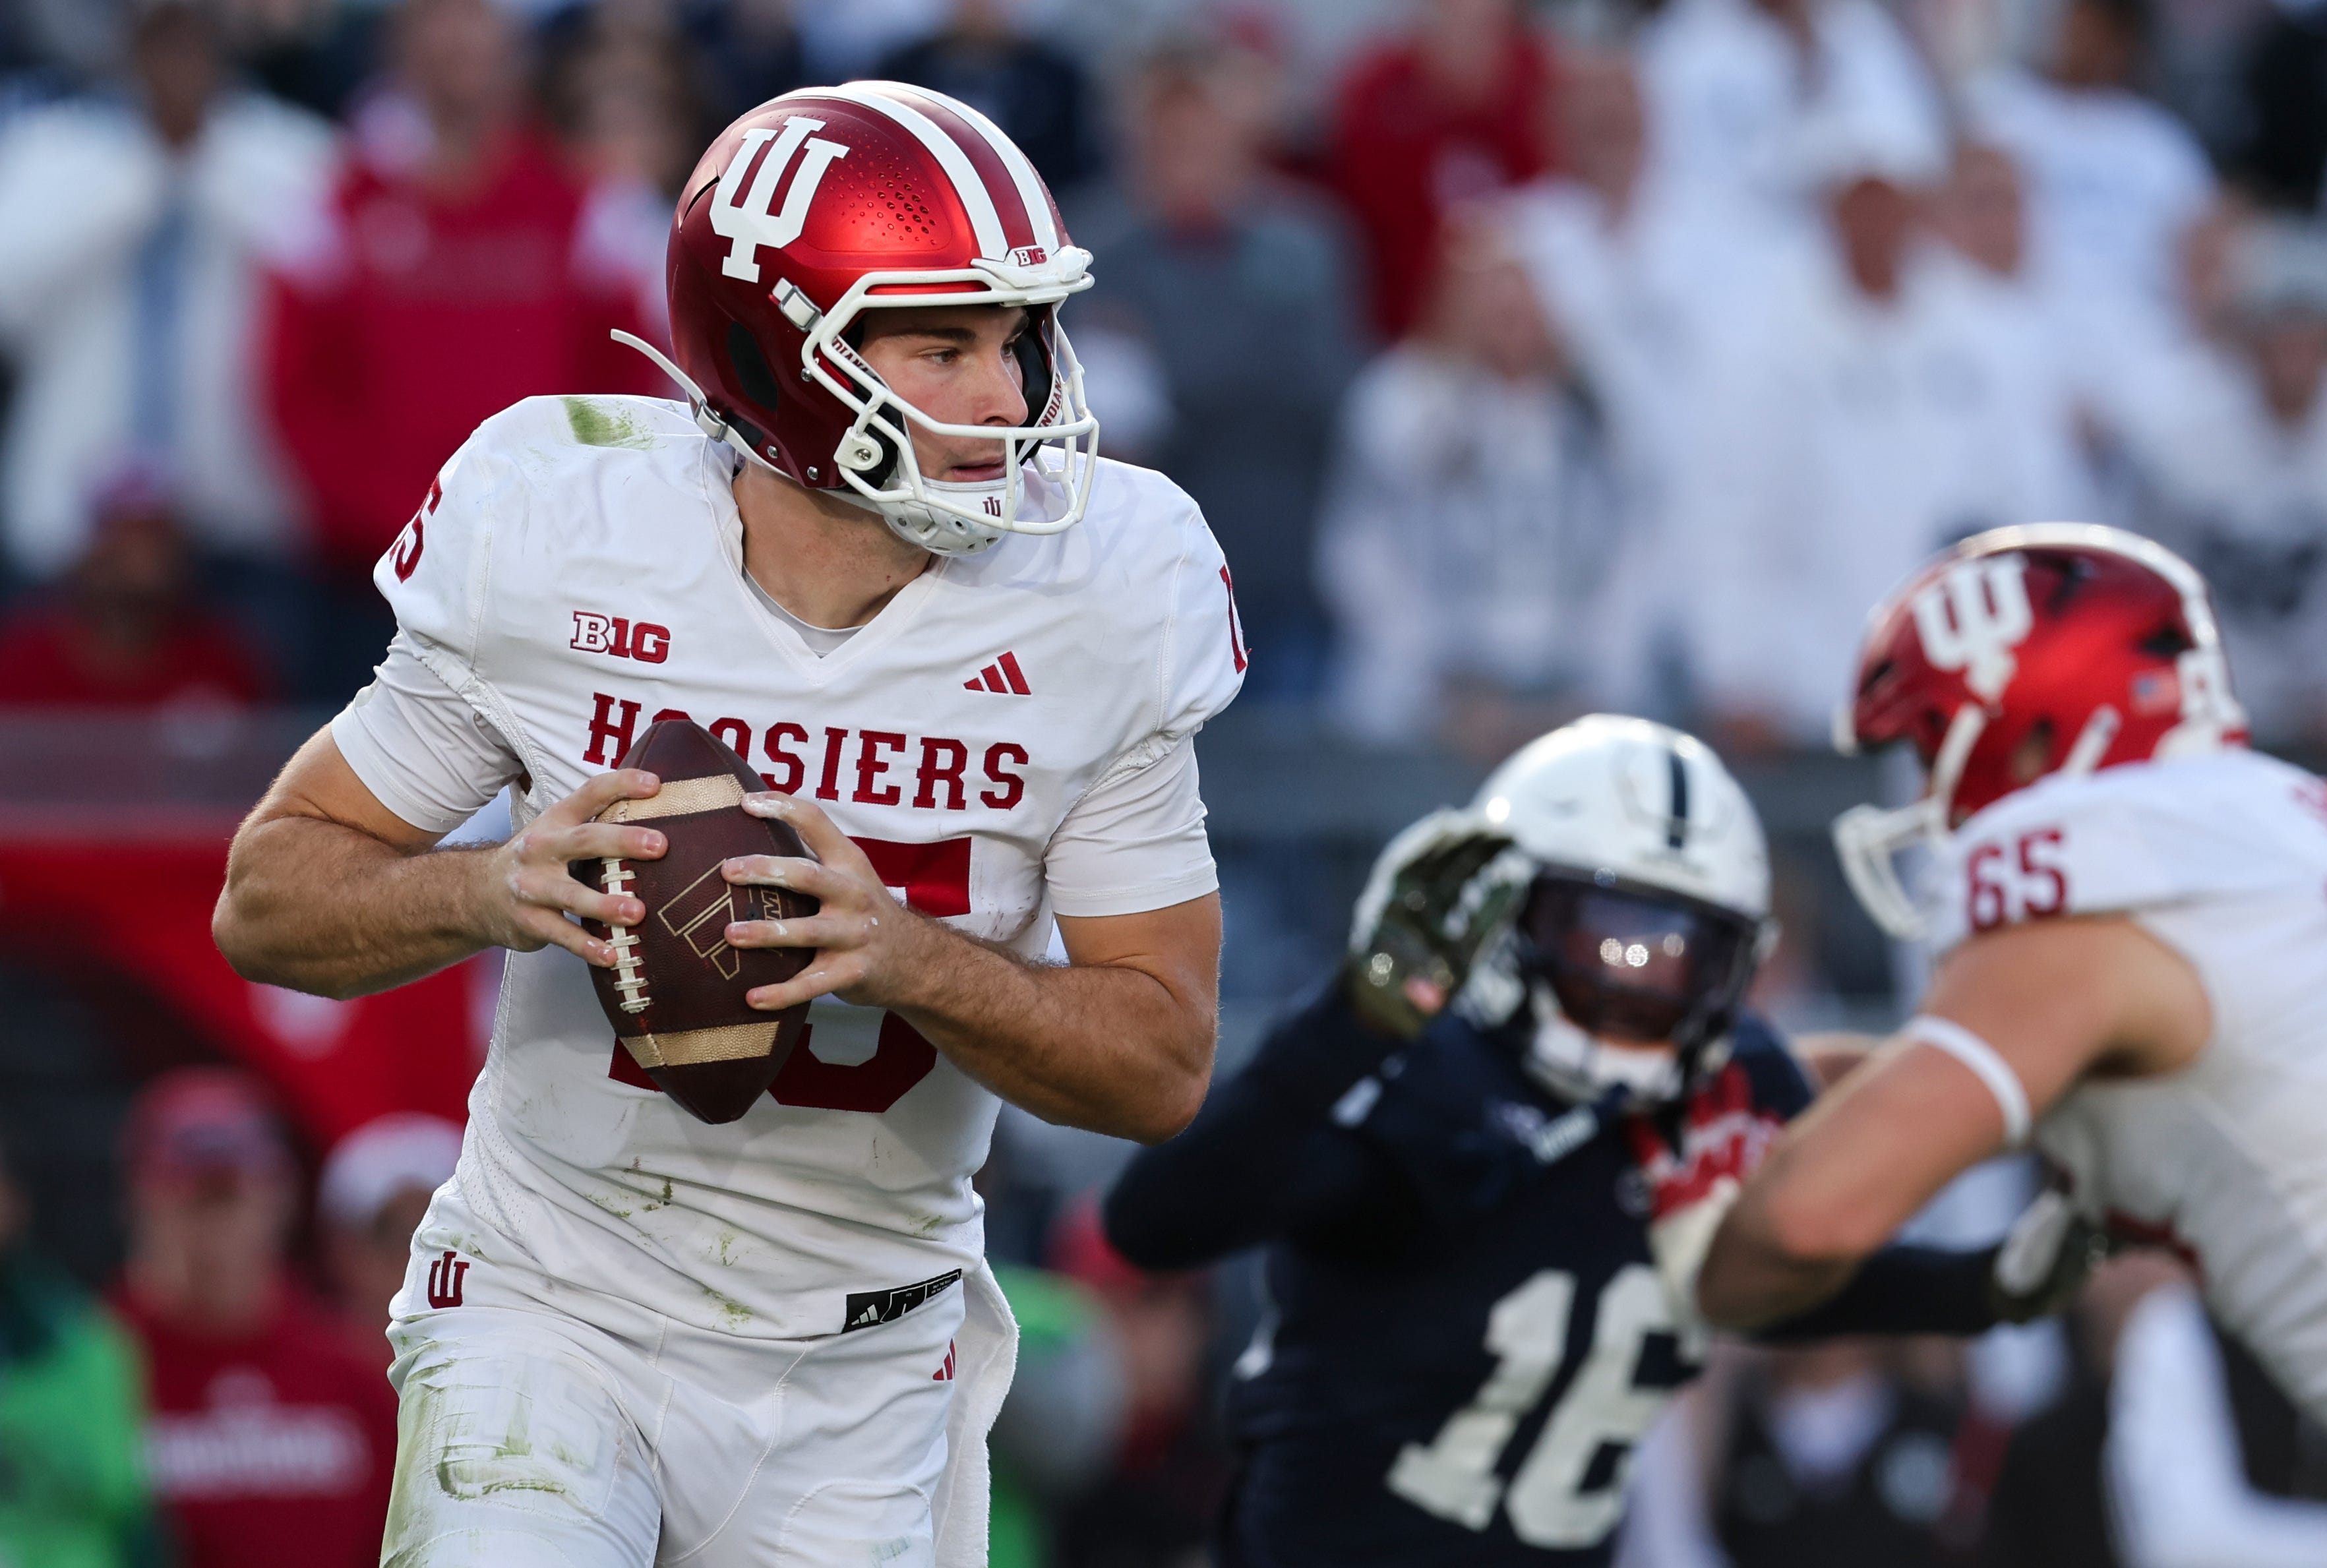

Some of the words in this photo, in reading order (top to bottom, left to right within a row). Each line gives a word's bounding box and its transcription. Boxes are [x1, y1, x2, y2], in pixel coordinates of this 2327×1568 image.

[389, 472, 443, 584] 5
[583, 692, 1029, 810] HOSIERS
[1966, 829, 2070, 934] 65
